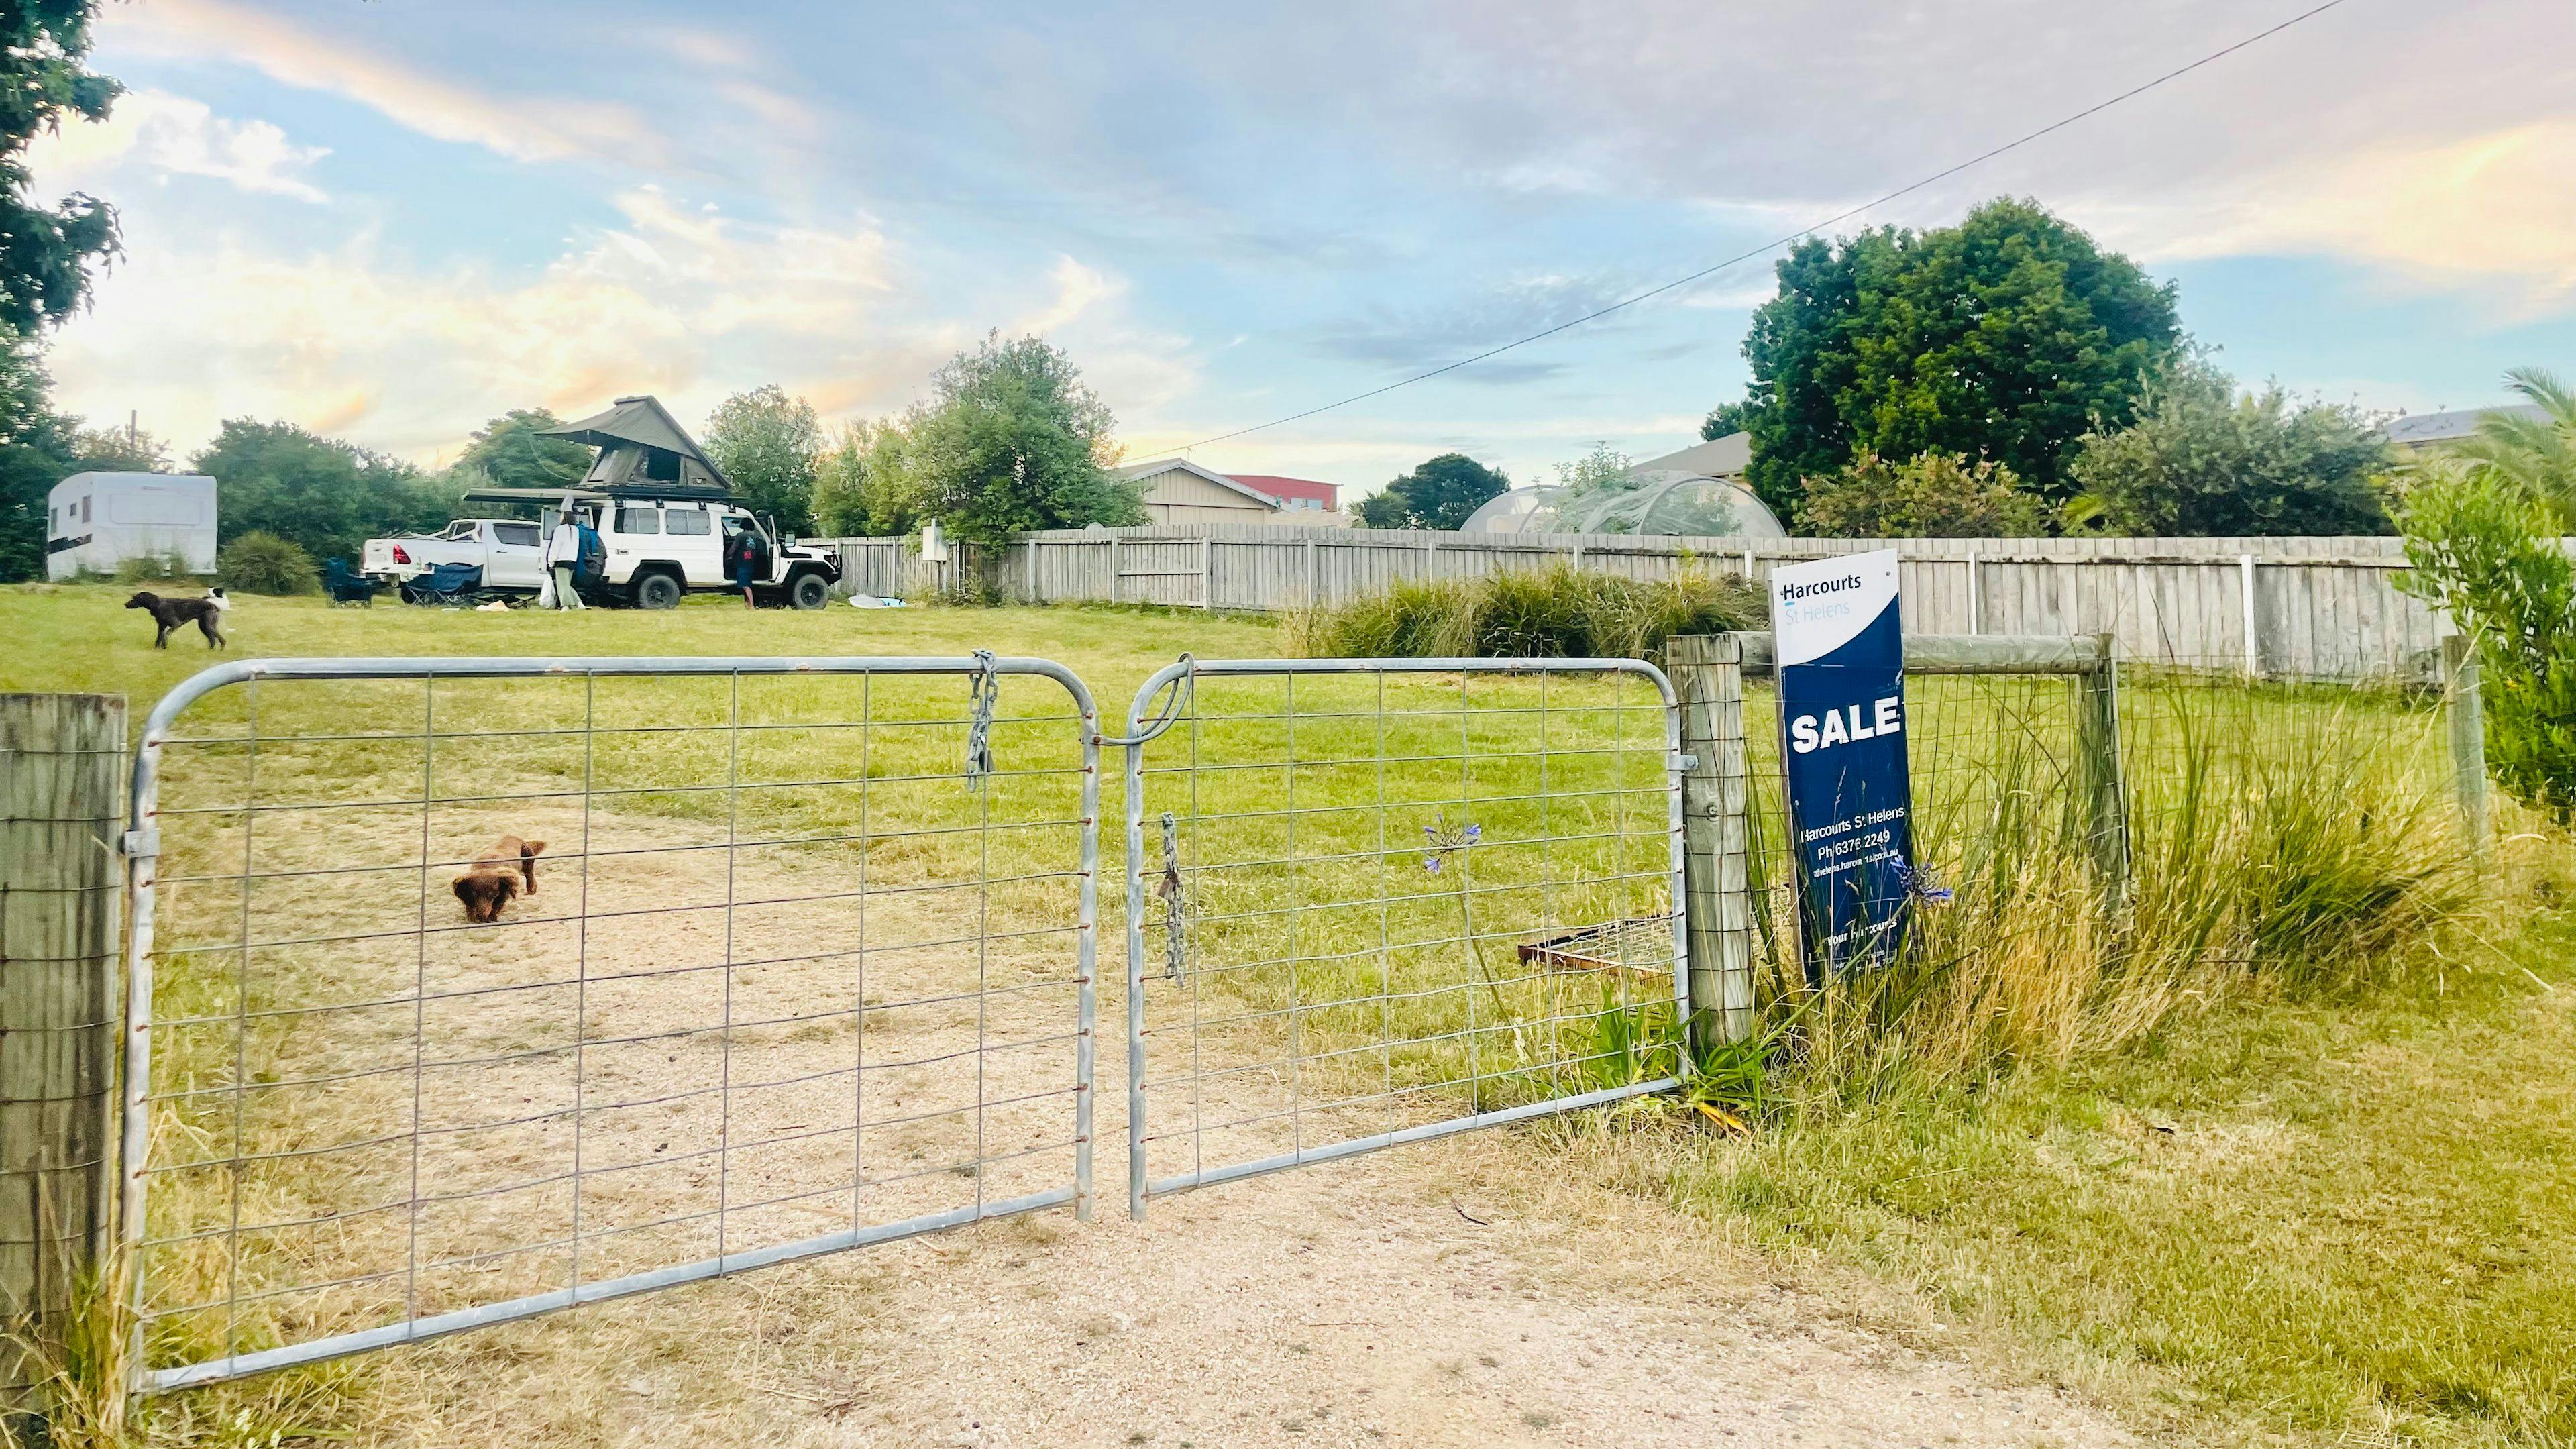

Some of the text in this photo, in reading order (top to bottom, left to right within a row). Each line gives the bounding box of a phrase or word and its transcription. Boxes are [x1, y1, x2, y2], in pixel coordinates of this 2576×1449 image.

[1783, 574, 1862, 600] Harcourts
[1785, 602, 1851, 625] St Helens
[1792, 696, 1901, 753] SALE
[1801, 820, 1852, 843] Harcourts
[1868, 806, 1905, 825] Helens
[1817, 845, 1833, 861] Ph
[1864, 830, 1890, 848] 2249
